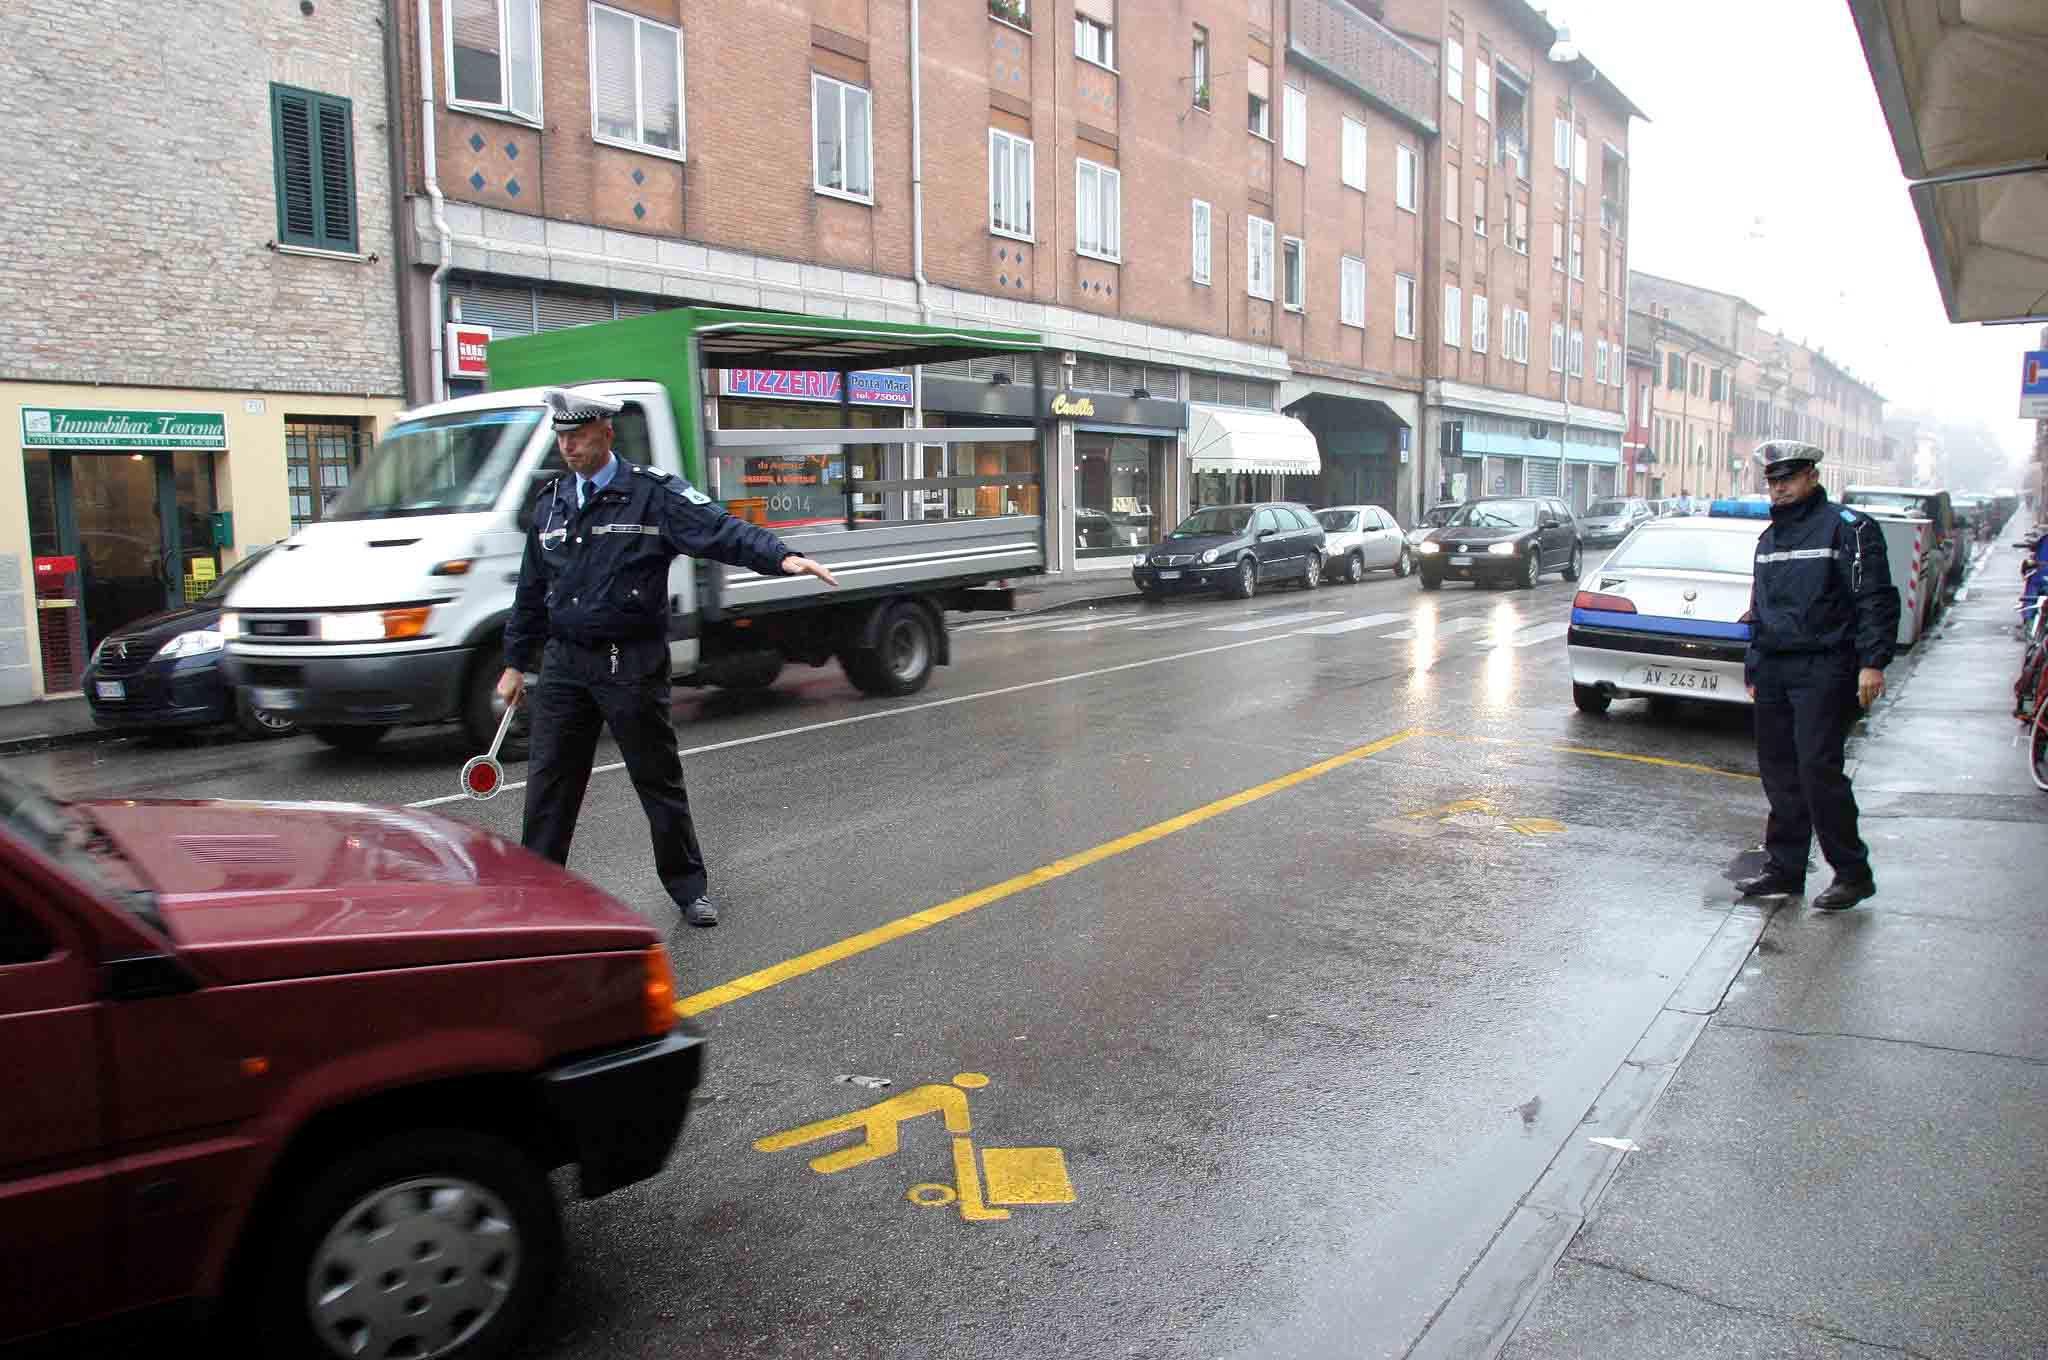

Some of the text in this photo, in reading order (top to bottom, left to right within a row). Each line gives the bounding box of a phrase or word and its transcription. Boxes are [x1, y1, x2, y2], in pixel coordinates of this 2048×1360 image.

[731, 368, 841, 398] PIZZERIA
[851, 375, 909, 392] Porta Mare
[55, 414, 222, 435] Immobiliare Teorema
[1670, 672, 1696, 687] 243
[1701, 675, 1719, 689] AW
